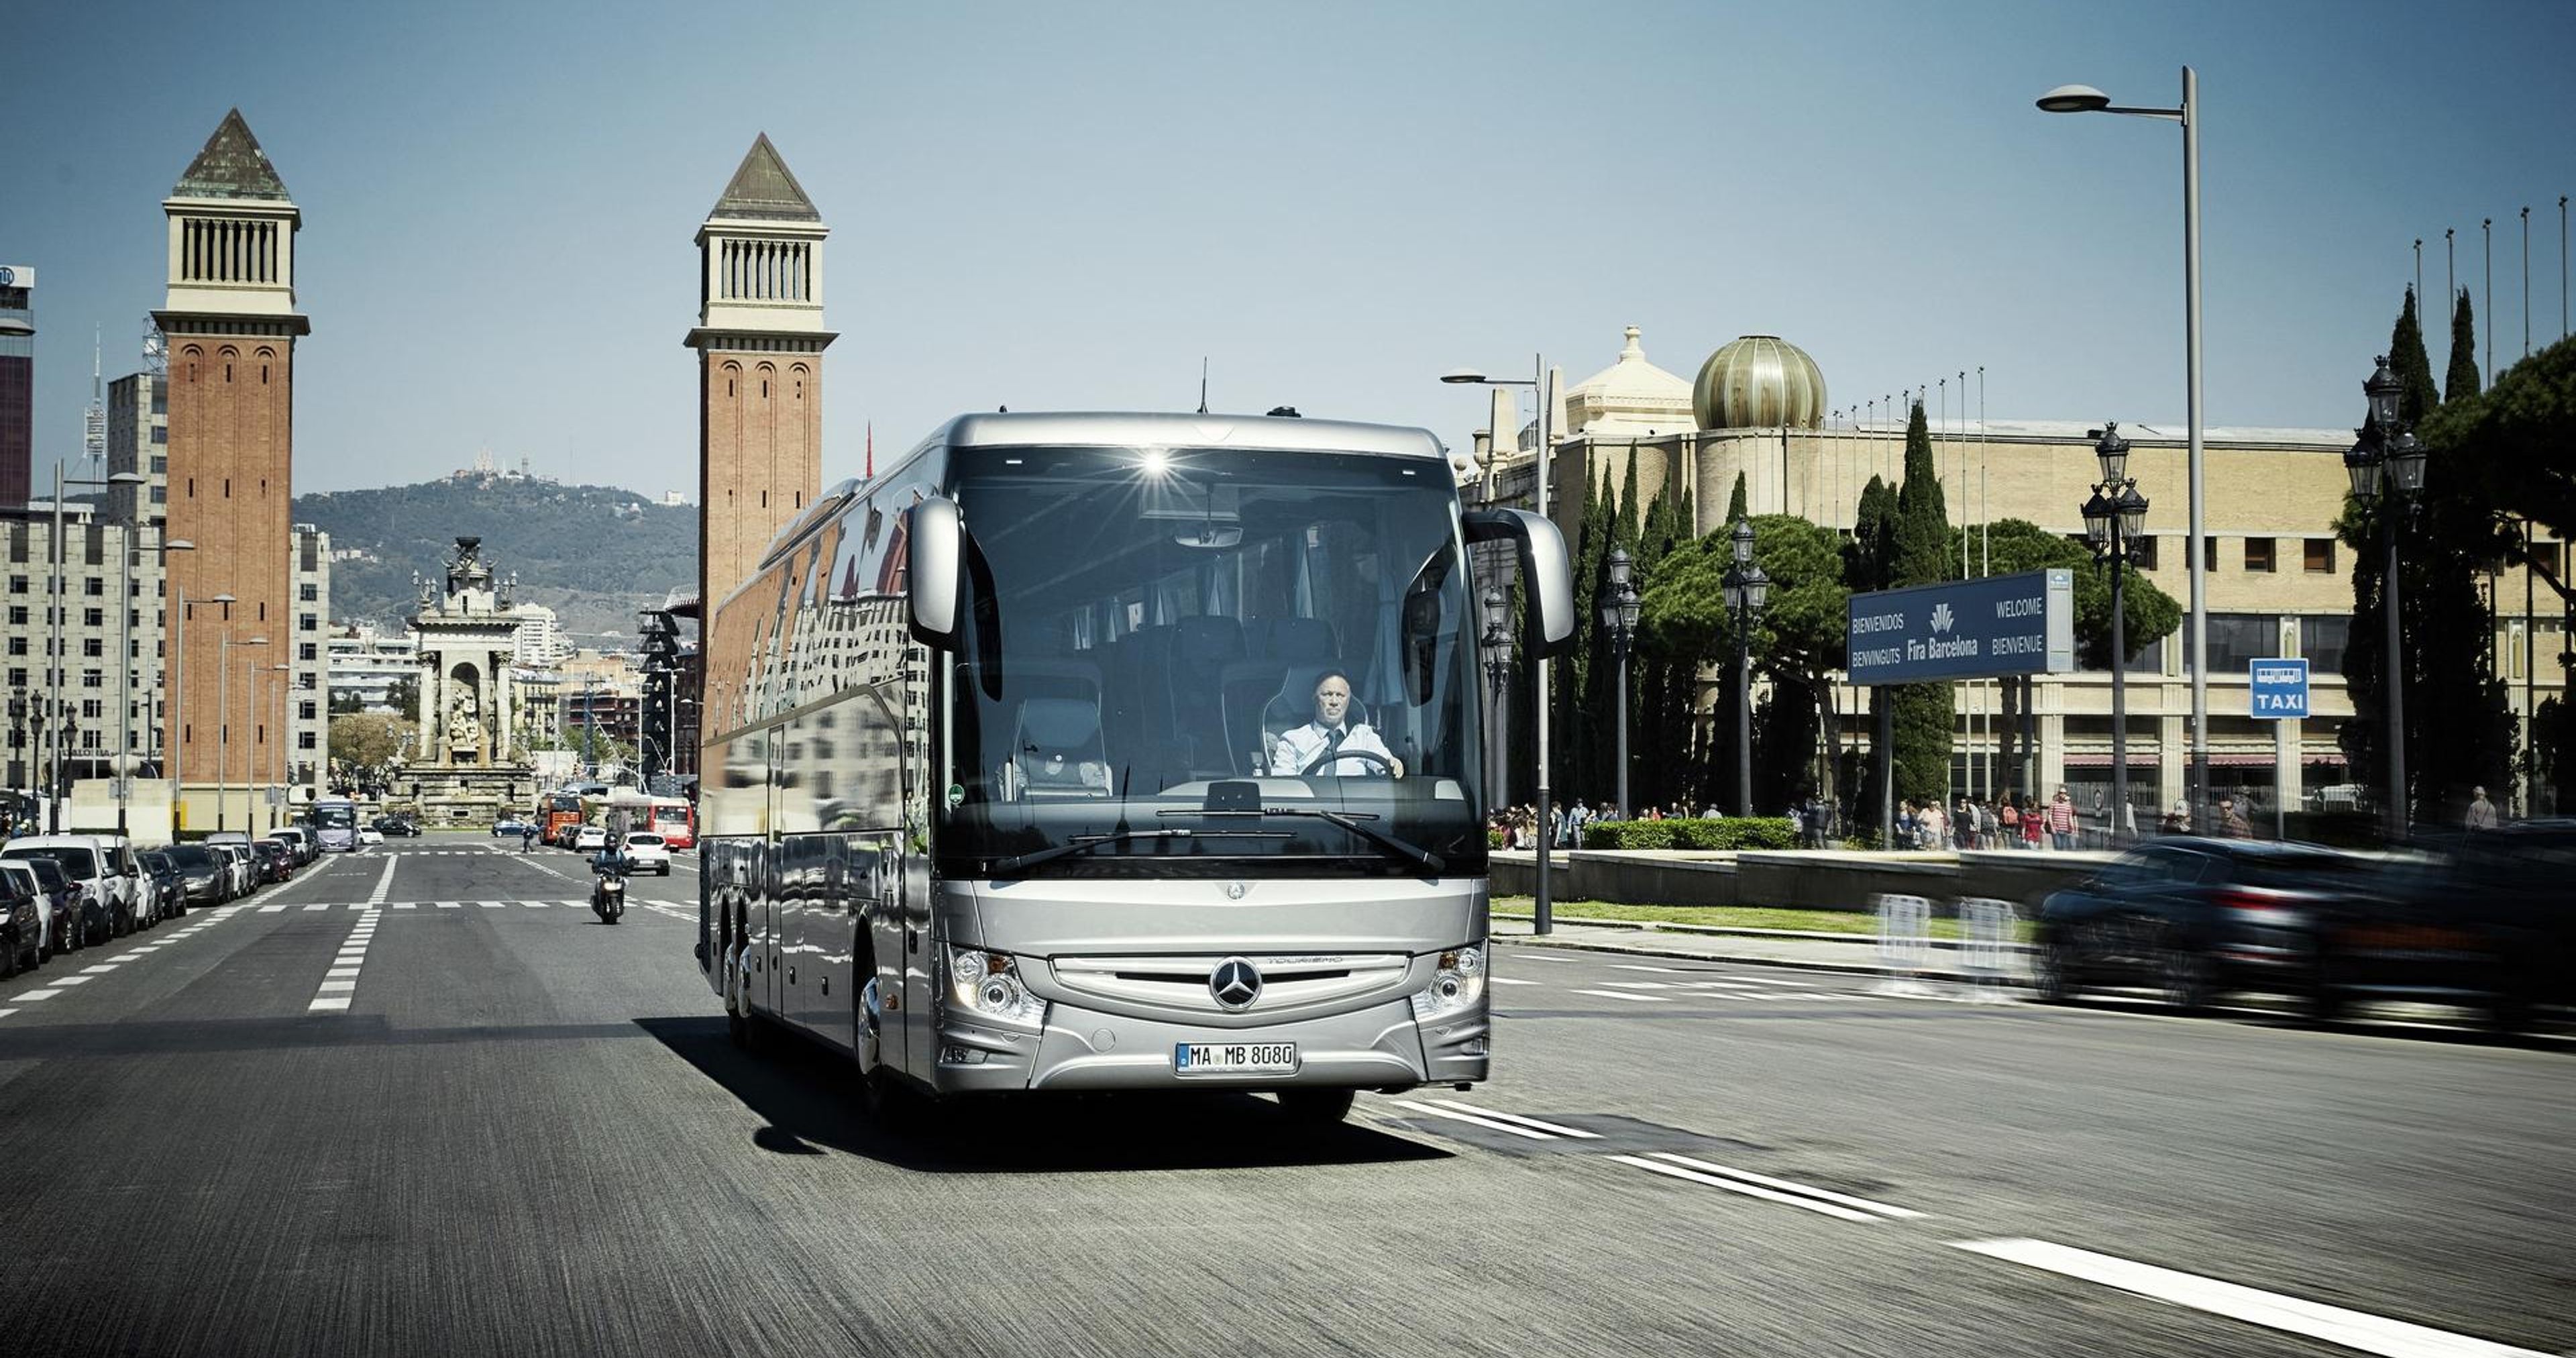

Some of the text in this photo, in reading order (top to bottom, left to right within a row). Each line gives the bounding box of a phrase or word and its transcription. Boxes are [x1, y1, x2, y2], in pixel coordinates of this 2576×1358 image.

[1996, 596, 2043, 618] WELCOME
[1853, 613, 1904, 634] BIENVENIDOS
[1908, 635, 1978, 661] Fira Barcelona
[1992, 635, 2043, 656] BIENVENUE
[1853, 647, 1900, 668] BENVINGUTS
[2257, 694, 2303, 709] TAXI
[1191, 1046, 1292, 1065] MA MB 8080
